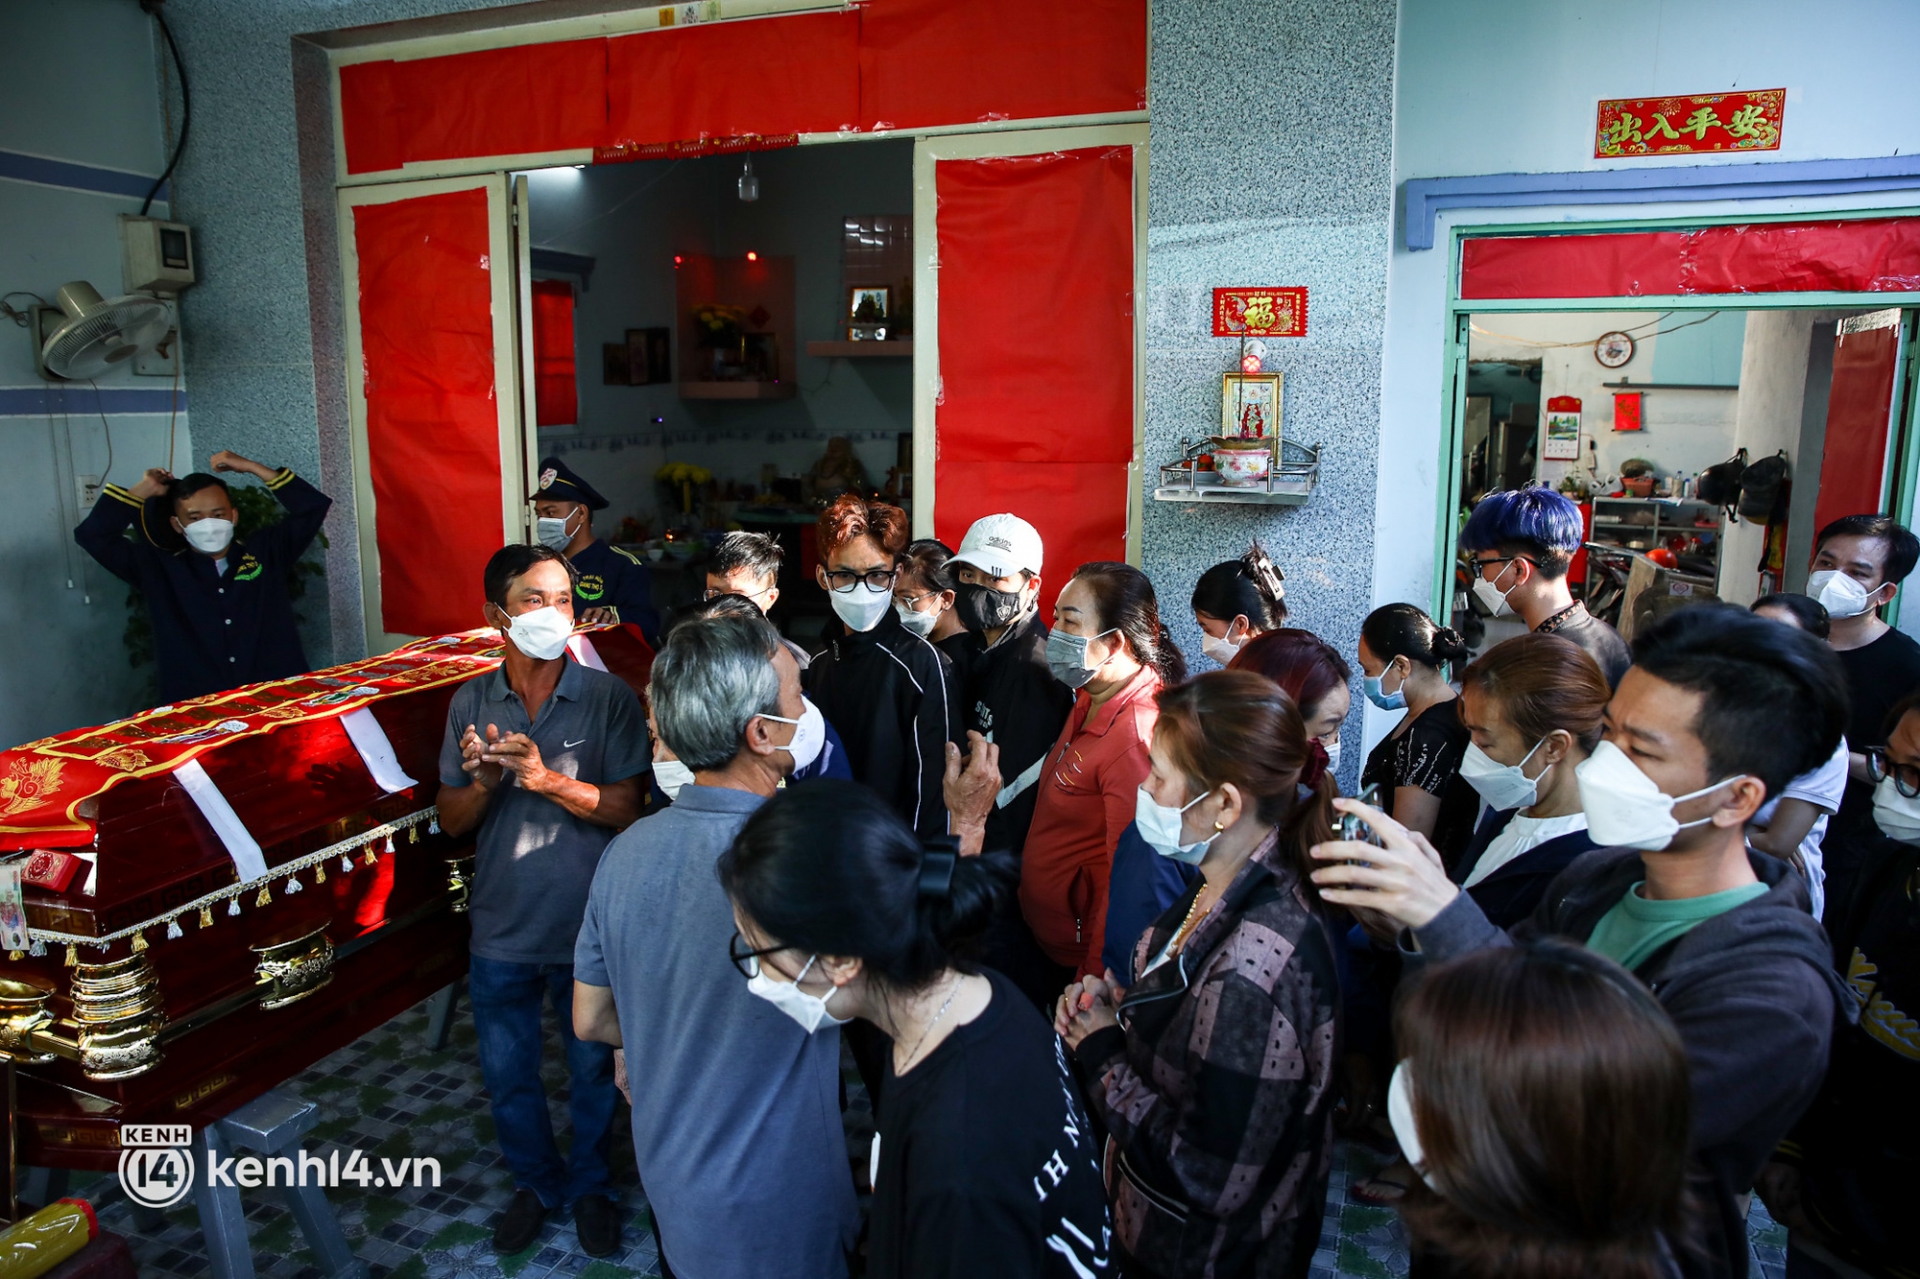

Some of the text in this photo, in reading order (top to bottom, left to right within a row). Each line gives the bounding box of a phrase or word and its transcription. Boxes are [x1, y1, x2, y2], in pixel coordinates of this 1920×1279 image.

[1609, 104, 1768, 144] 出入平安
[1243, 296, 1277, 329] 福
